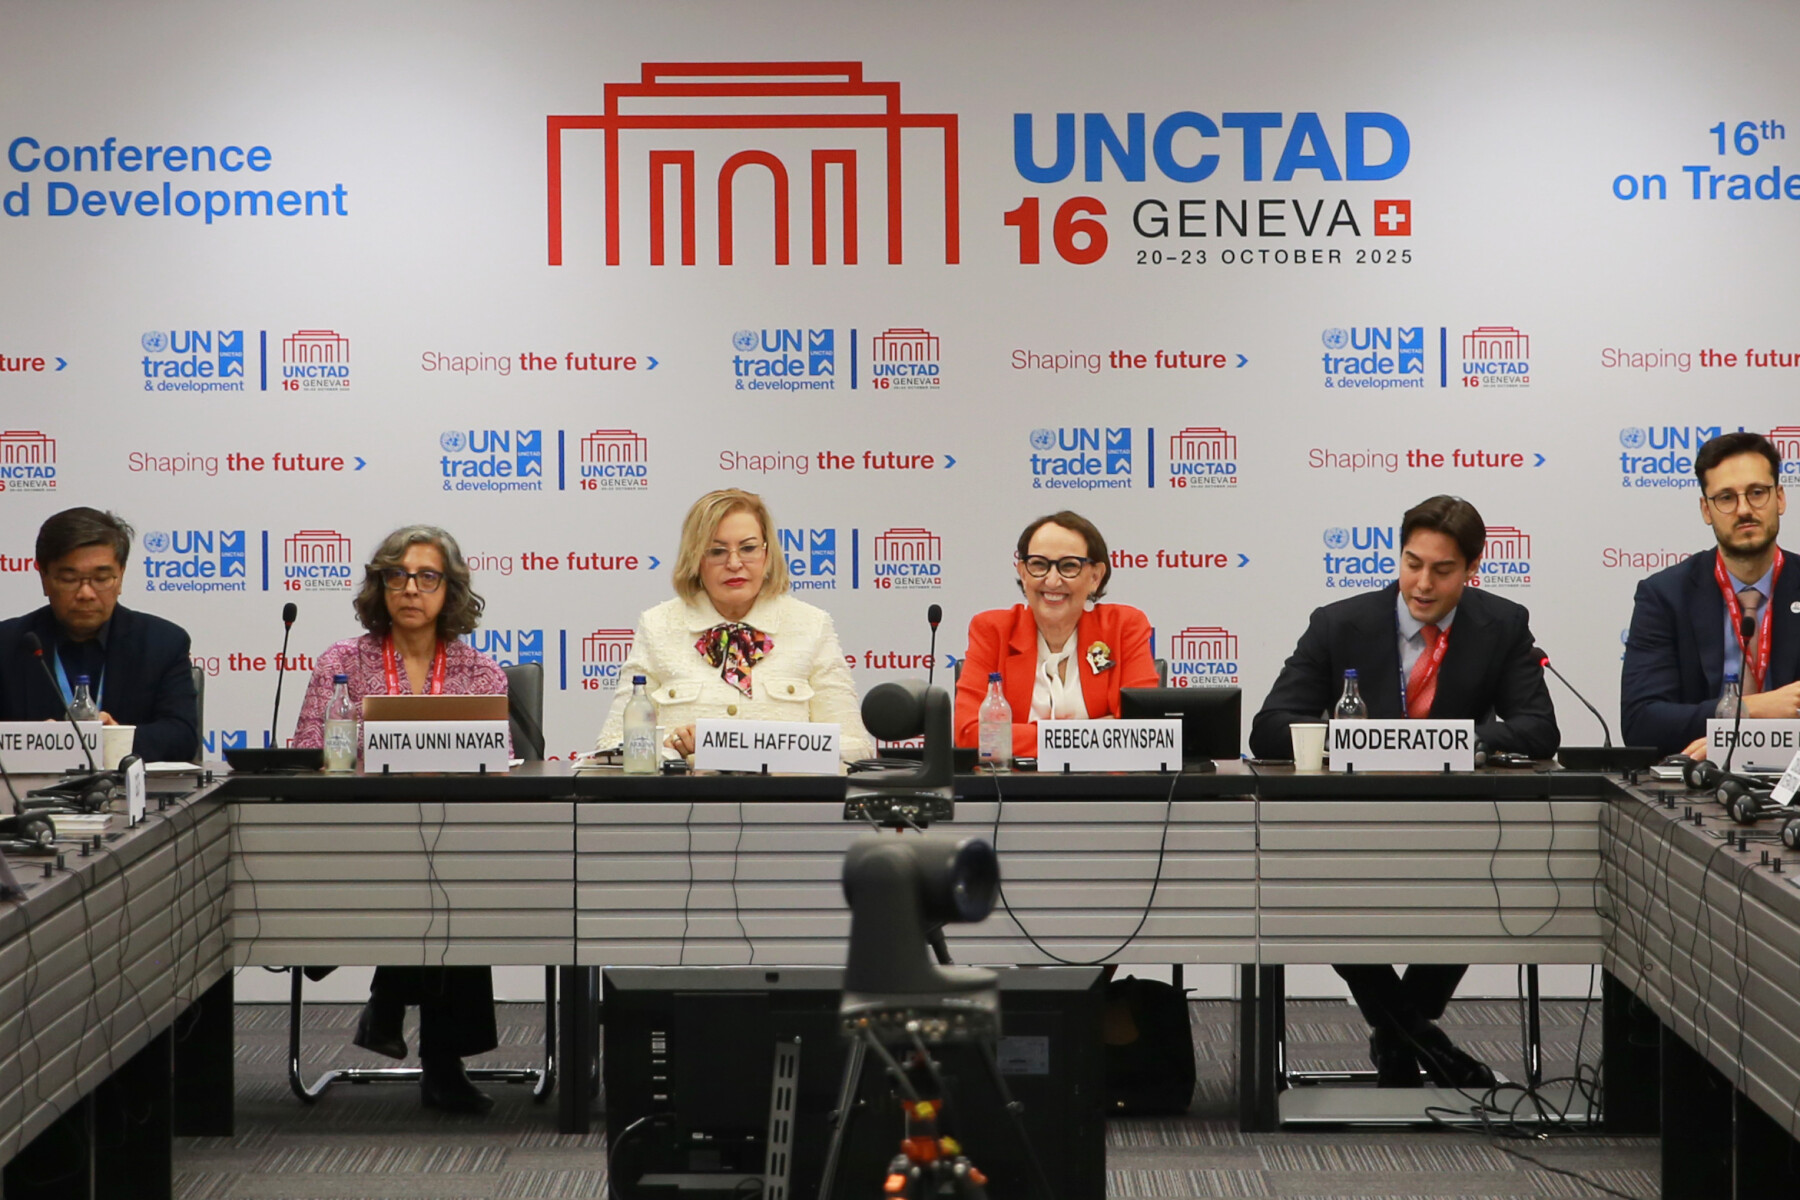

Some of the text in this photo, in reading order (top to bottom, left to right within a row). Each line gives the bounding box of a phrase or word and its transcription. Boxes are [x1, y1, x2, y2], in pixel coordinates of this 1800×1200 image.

[7, 136, 271, 173] Conference
[1013, 111, 1410, 183] UNCTAD
[1613, 165, 1800, 200] on Trade
[46, 181, 348, 224] Development
[1004, 196, 1361, 265] 16 GENEVA
[1222, 249, 1340, 264] OCTOBER
[1356, 249, 1411, 263] 2025
[171, 331, 211, 353] UN
[762, 329, 802, 352] UN
[1351, 328, 1391, 350] UN
[0, 354, 45, 371] ture
[142, 355, 213, 377] trade
[422, 352, 636, 376] Shaping the future
[733, 353, 804, 376] trade
[873, 364, 939, 376] UNCTAD
[1012, 350, 1226, 374] Shaping the future
[1322, 351, 1394, 374] trade
[1463, 362, 1529, 374] UNCTAD
[1602, 348, 1800, 372] Shaping the futur
[283, 366, 349, 378] UNCTAD
[1462, 376, 1479, 387] 16
[144, 380, 244, 393] & development
[282, 380, 299, 391] 16
[735, 376, 834, 392] & development
[872, 378, 889, 389] 16
[1325, 377, 1424, 390] & development
[469, 430, 510, 452] UN
[1059, 428, 1099, 450] UN
[1649, 427, 1689, 449] UN
[129, 452, 344, 476] Shaping the future
[440, 454, 512, 477] trade
[581, 465, 647, 477] UNCTAD
[720, 451, 934, 474] Shaping the future
[1030, 452, 1101, 474] trade
[1171, 463, 1236, 475] UNCTAD
[1309, 449, 1523, 473] Shaping the future
[1620, 451, 1692, 473] trade
[1, 466, 56, 478] NCTAD
[443, 480, 542, 493] & development
[580, 479, 597, 490] 16
[1033, 477, 1131, 491] & development
[1169, 477, 1186, 488] 16
[1622, 476, 1700, 489] & developm
[173, 531, 213, 553] UN
[778, 529, 803, 551] N
[1353, 527, 1393, 550] UN
[144, 555, 215, 577] trade
[467, 552, 638, 576] ping the future
[1108, 550, 1227, 570] the future
[1324, 551, 1395, 574] trade
[1480, 562, 1530, 574] NCTAD
[285, 566, 351, 578] UNCTAD
[875, 564, 941, 578] UNCTAD
[146, 580, 245, 593] & development
[284, 580, 301, 591] 16
[874, 577, 891, 589] 16
[1326, 576, 1391, 589] & develop
[470, 630, 510, 652] UN
[228, 653, 266, 671] the
[864, 650, 935, 669] future
[1172, 663, 1237, 674] UNCTAD
[583, 665, 622, 677] UNC
[582, 678, 599, 690] 16
[1169, 676, 1190, 689] 16
[26, 733, 75, 750] PAOLO
[369, 733, 504, 749] ANITA UNNI NAYAR
[703, 731, 831, 751] AMEL HAFFOUZ
[1045, 729, 1173, 749] REBECA GRYNSPAN
[1336, 729, 1468, 750] MODERATOR
[1714, 727, 1792, 747] ÉRICO DE
